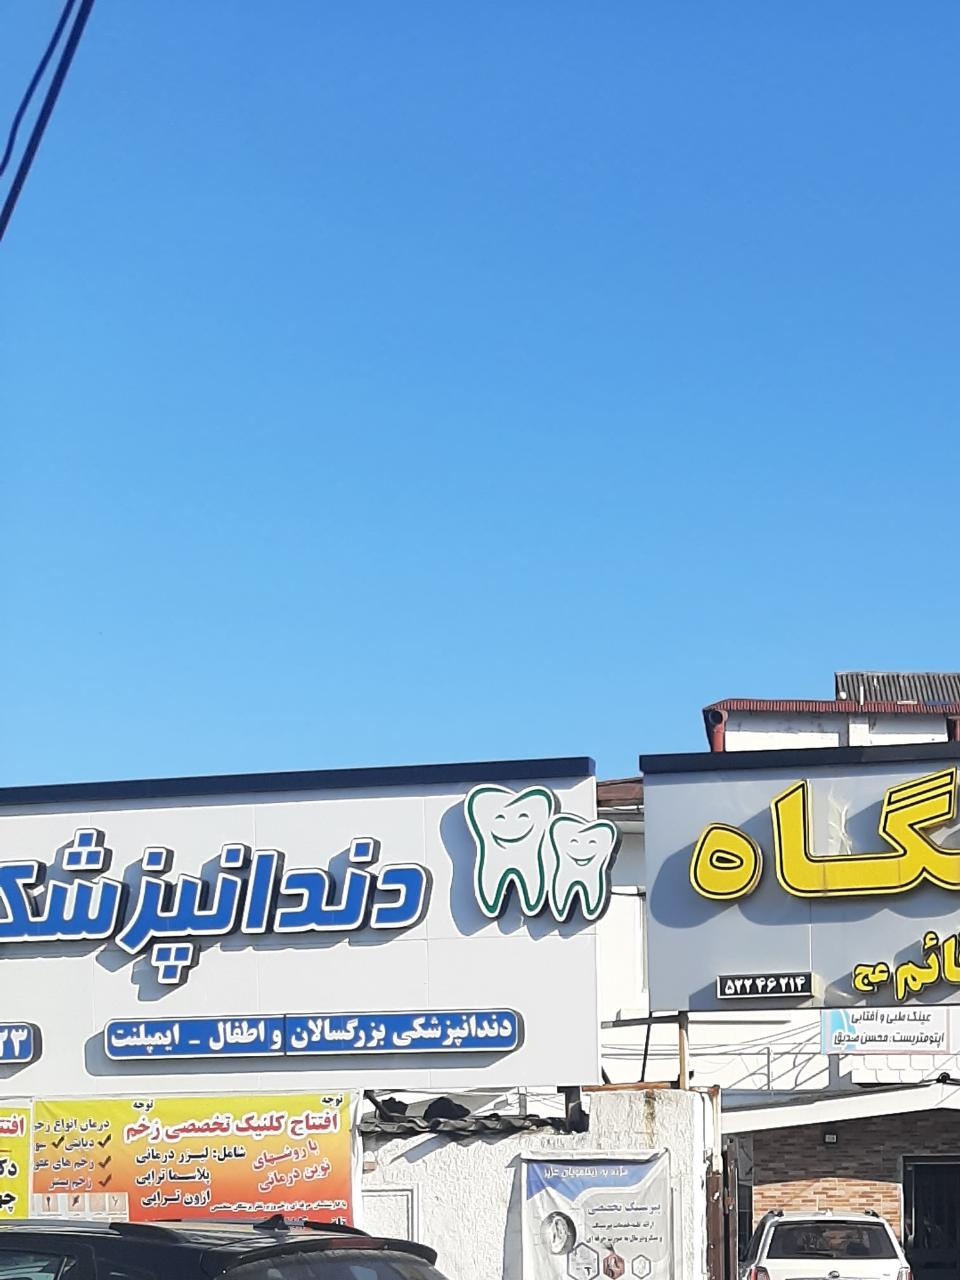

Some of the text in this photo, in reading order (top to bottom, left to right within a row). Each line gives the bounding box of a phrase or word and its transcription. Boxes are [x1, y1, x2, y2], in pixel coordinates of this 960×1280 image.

[0, 826, 430, 984] دندانپزشک
[111, 1022, 180, 1054] ایمپلنت
[208, 1020, 265, 1051] اطفال
[290, 1018, 387, 1048] بزرگسالان
[392, 1014, 513, 1047] دندانپزشکی
[127, 1117, 161, 1140] زخم
[165, 1116, 231, 1140] تخصصی
[290, 1111, 338, 1136] افتتاح
